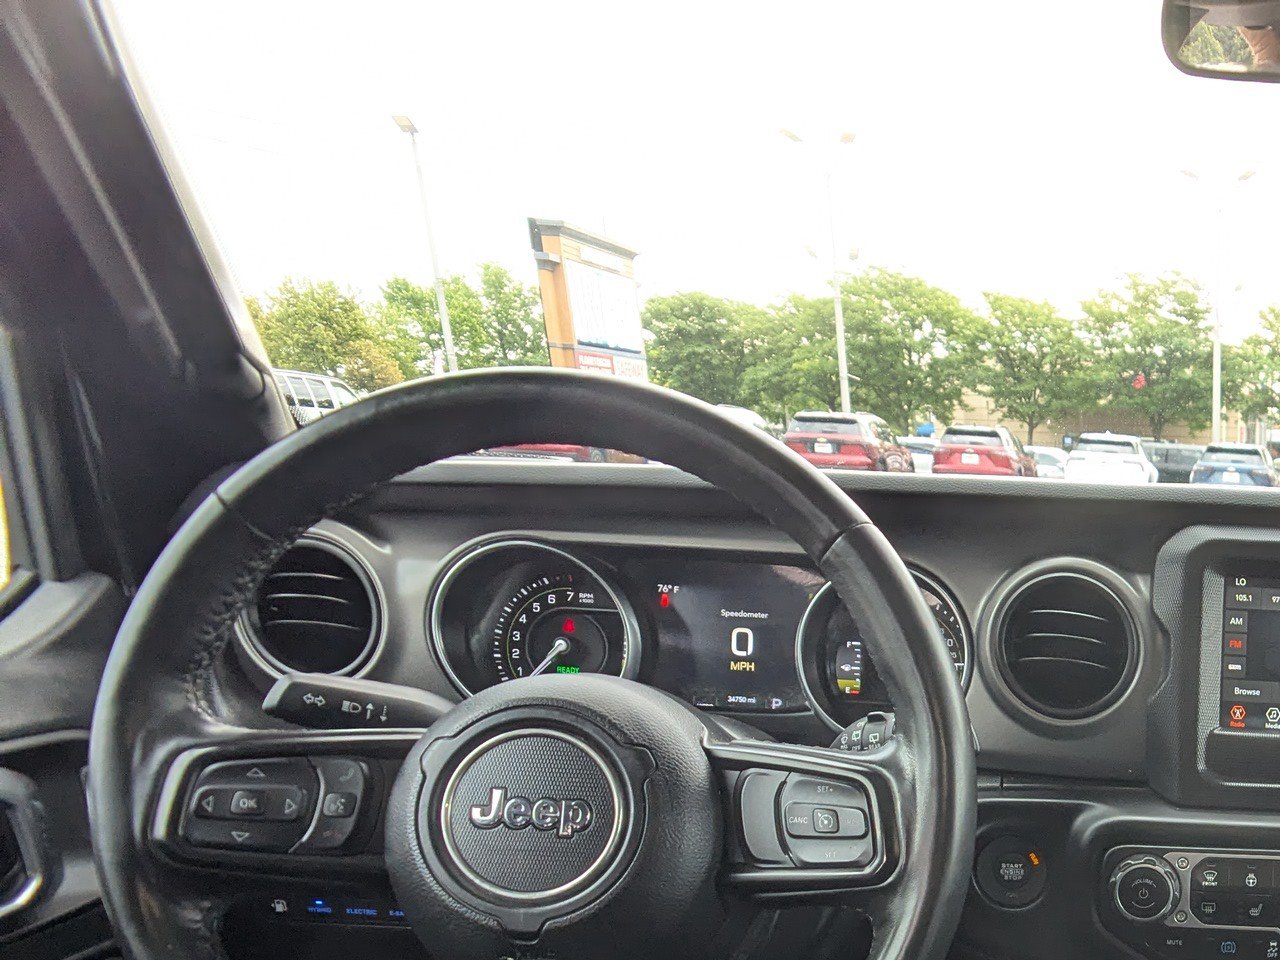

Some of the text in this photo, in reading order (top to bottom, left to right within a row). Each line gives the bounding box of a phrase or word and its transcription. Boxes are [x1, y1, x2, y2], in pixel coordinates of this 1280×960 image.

[1235, 578, 1247, 586] LO
[657, 583, 680, 594] 76° F
[1235, 594, 1252, 602] 105.1
[720, 609, 768, 619] Speedometer
[1230, 617, 1243, 625] AM
[512, 591, 574, 676] 1 2 3 4 5 6 7
[731, 627, 754, 656] 0
[1229, 639, 1242, 648] FM
[556, 666, 580, 674] READY
[730, 661, 755, 671] MPH
[1234, 686, 1260, 696] Browse
[727, 695, 756, 704] 34750 mi
[771, 698, 782, 709] P
[239, 798, 257, 808] OK
[471, 788, 591, 836] Jeep
[789, 816, 808, 824] CANC
